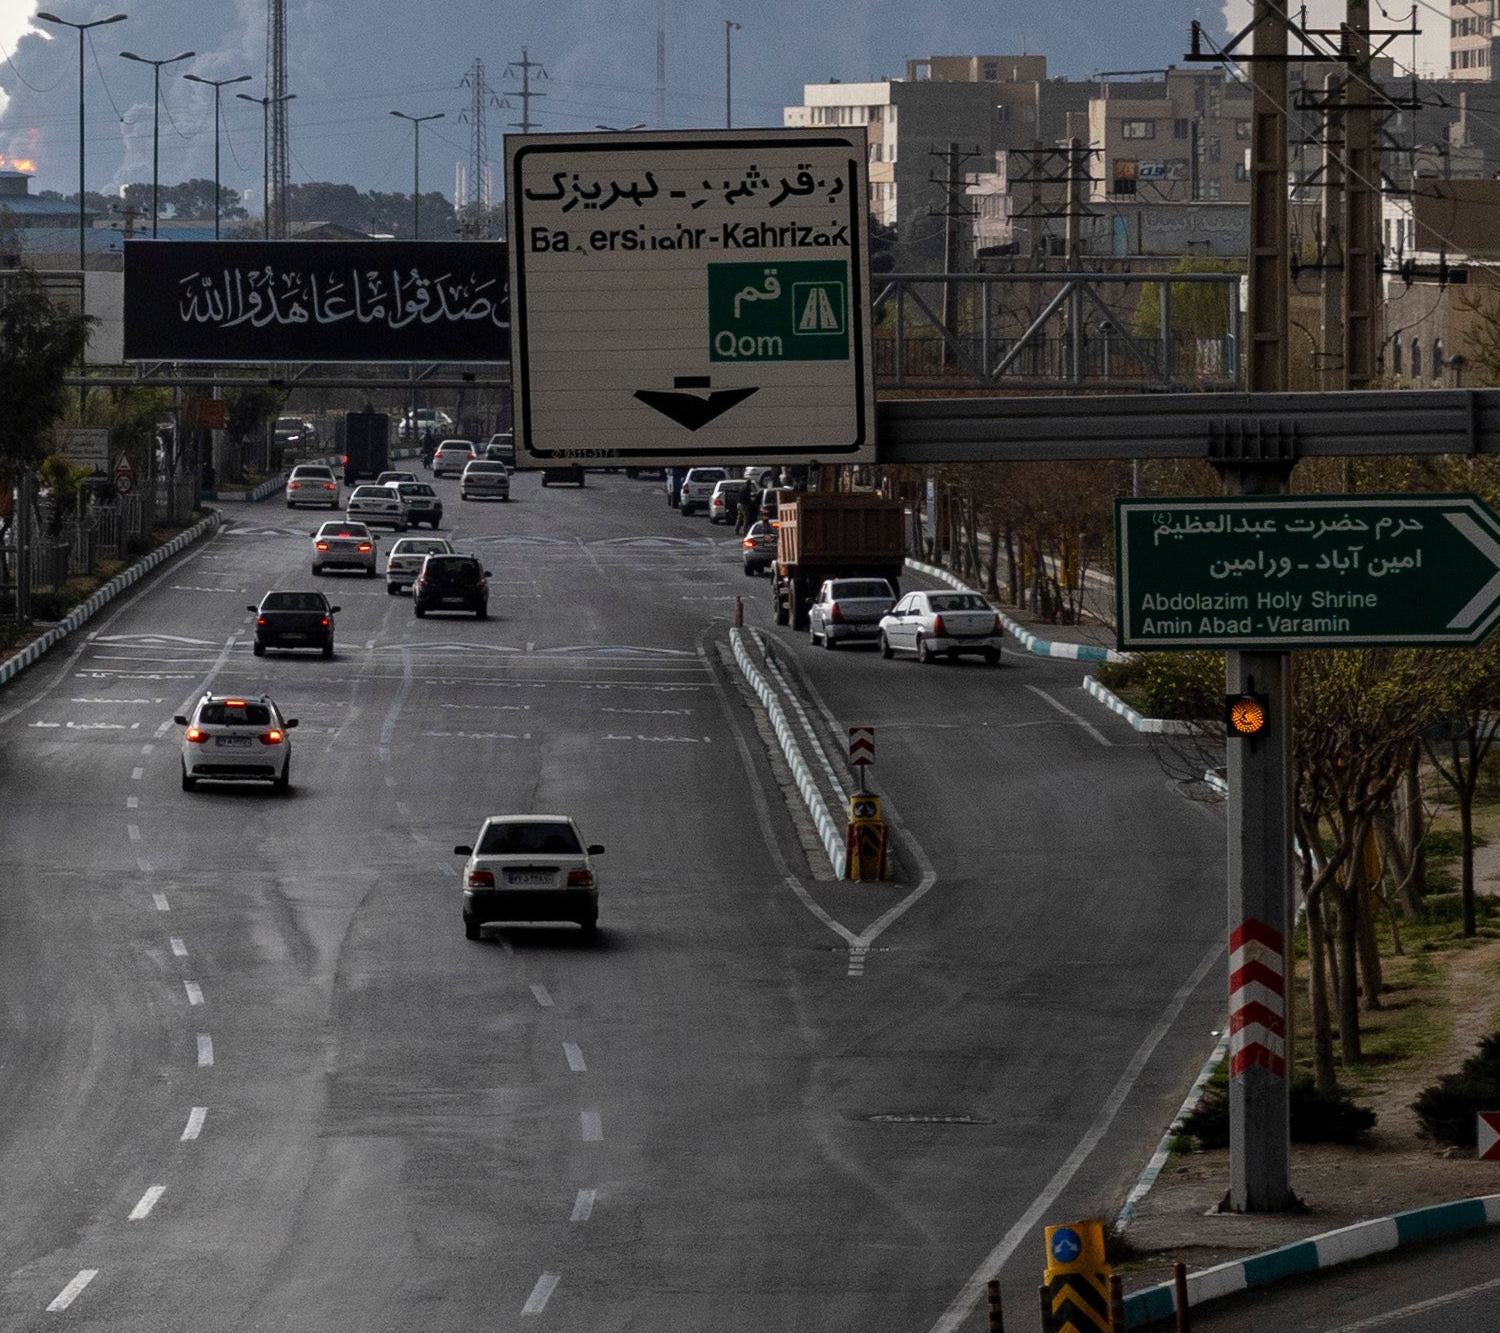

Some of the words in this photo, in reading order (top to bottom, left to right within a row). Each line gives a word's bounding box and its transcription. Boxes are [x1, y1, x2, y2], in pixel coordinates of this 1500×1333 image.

[733, 268, 782, 319] قم
[714, 330, 783, 360] Qom
[1153, 513, 1276, 545] عبدالعظیم
[1285, 513, 1369, 539] حضرت
[1375, 517, 1424, 540] حرم
[1210, 552, 1291, 579] ورامین
[1315, 545, 1364, 571] آباد
[1367, 550, 1422, 576] امین
[1141, 591, 1249, 612] Abdolazim
[1257, 592, 1302, 615] Holy
[1311, 590, 1377, 609] Shrine
[1142, 616, 1192, 634] Amin
[1199, 616, 1251, 634] Abad
[1267, 614, 1350, 633] Varamin
